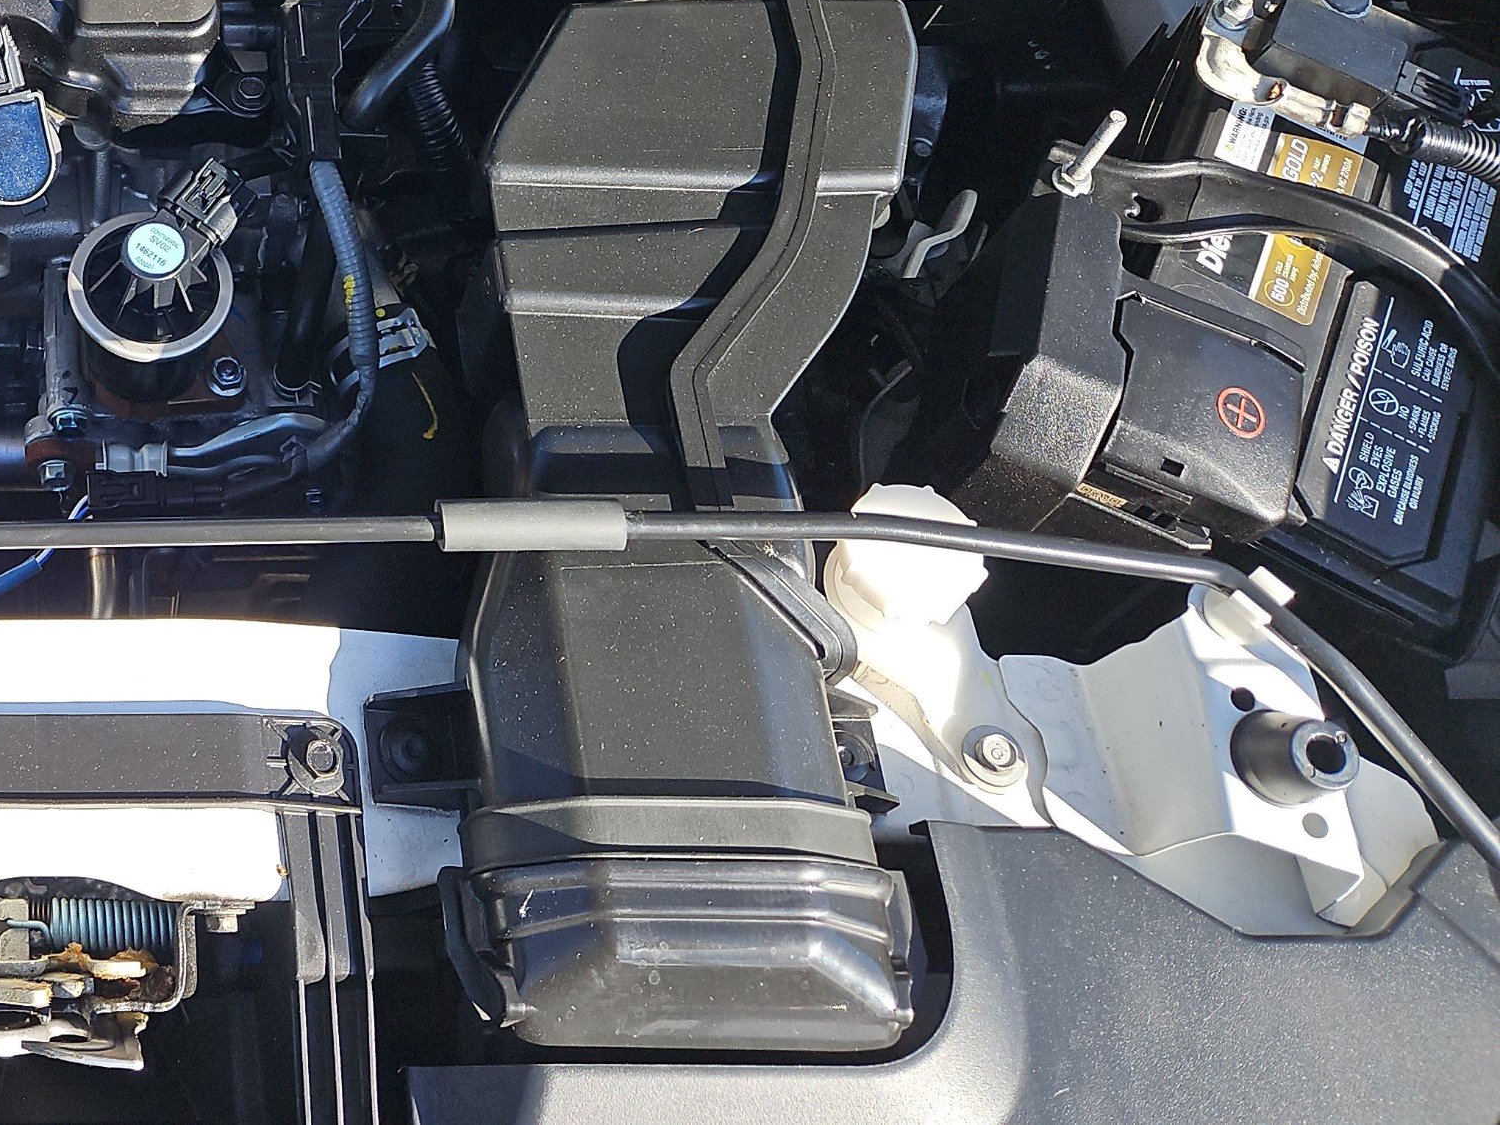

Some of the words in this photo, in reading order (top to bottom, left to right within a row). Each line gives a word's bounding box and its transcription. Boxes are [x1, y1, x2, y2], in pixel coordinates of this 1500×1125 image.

[1228, 107, 1247, 144] WARNING:
[1281, 137, 1309, 182] GOLD
[1429, 178, 1441, 196] EYES
[1270, 276, 1290, 302] 500
[1295, 278, 1314, 315] Distributed
[1411, 336, 1429, 377] SULFURIC
[1421, 319, 1433, 339] ACID
[1425, 346, 1437, 368] CAUSE
[1326, 388, 1359, 456] DANGER
[1348, 316, 1379, 376] POISON
[1398, 405, 1409, 419] NO
[1358, 431, 1375, 462] SHIELD
[1369, 444, 1383, 468] EYES
[1375, 446, 1396, 493] EXPLOSIVE
[1386, 467, 1402, 498] GASES
